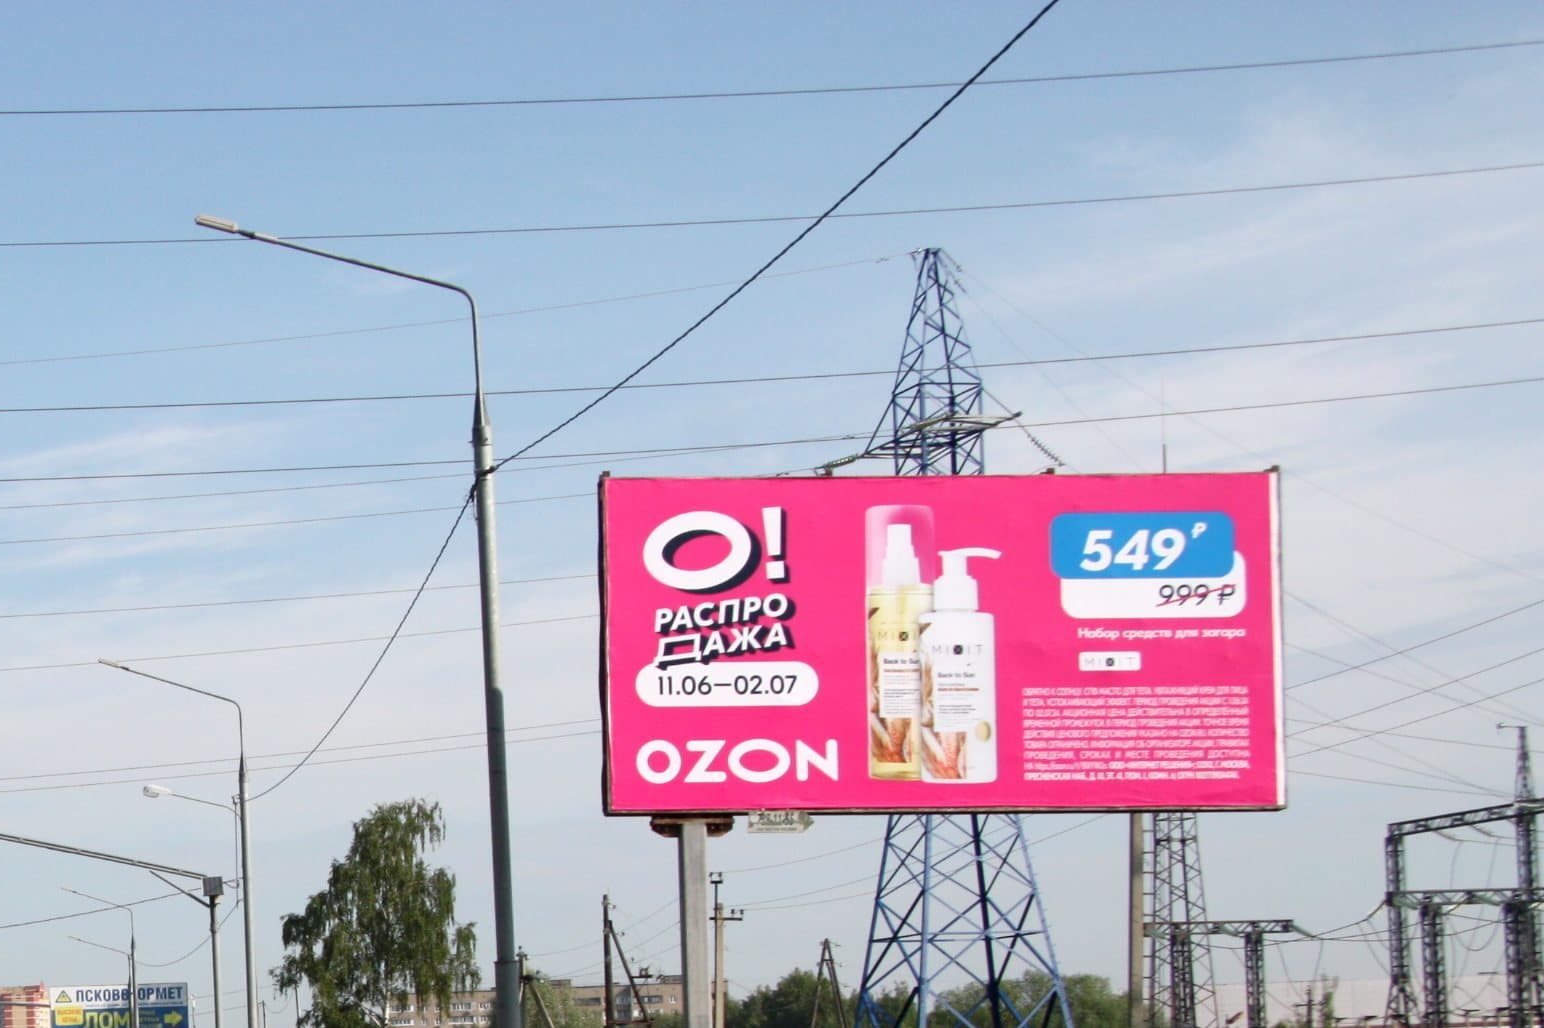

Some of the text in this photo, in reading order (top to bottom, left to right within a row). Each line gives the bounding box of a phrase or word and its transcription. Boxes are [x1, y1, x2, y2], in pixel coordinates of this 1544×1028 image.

[654, 593, 792, 633] РАСПРО
[653, 622, 792, 664] ДАЖА
[1077, 627, 1247, 641] Набор средств для загара
[636, 738, 839, 785] OZON
[76, 986, 183, 1003] ПСКОВВОРМЕТ
